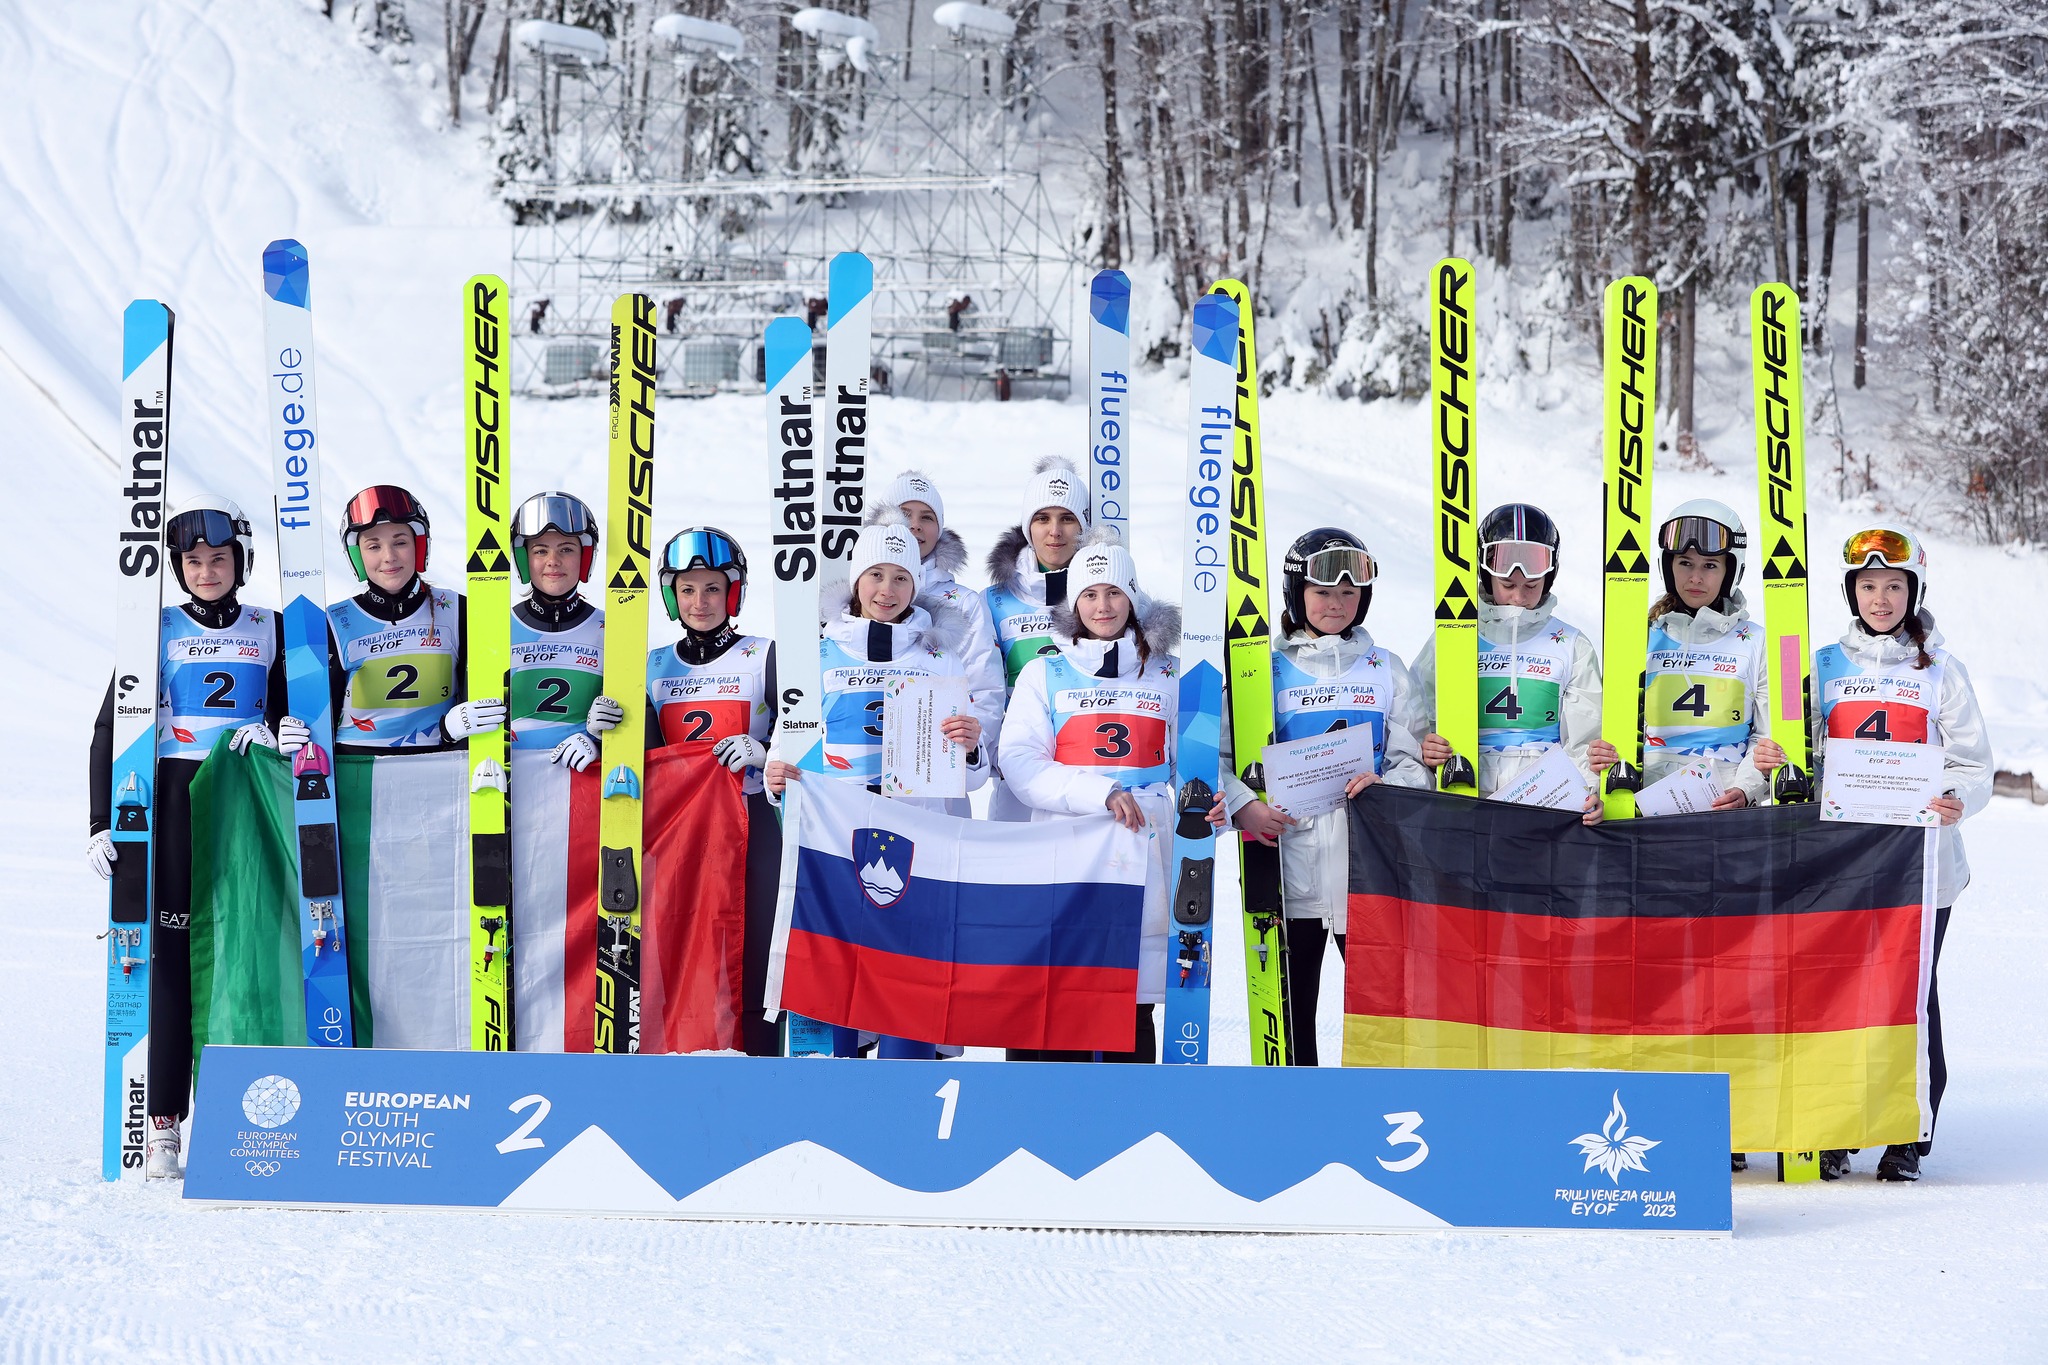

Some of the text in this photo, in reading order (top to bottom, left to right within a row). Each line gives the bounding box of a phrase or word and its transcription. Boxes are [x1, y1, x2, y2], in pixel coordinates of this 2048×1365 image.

[474, 282, 500, 522] FISCHER
[1617, 283, 1647, 524] FISCHER
[1761, 290, 1794, 529] FISCHER
[611, 405, 619, 439] EAGLE
[1439, 264, 1471, 572] FISCHER
[627, 293, 657, 560] FISCHER
[273, 347, 314, 529] fluege.de
[821, 385, 867, 561] Slatnar
[119, 398, 163, 577] Slatnar
[773, 395, 817, 581] Slatnar
[1189, 405, 1231, 592] fluege.de
[283, 567, 322, 578] fluege.de
[1284, 562, 1303, 573] uvex
[1008, 615, 1032, 627] FRIULI
[1020, 622, 1055, 633] EYOF
[178, 637, 259, 648] FRIULI VENEZIA GIULIA
[357, 629, 415, 648] FRIULI VENEZIA
[1183, 632, 1223, 642] fluege.de
[1231, 640, 1268, 648] FISCHER
[188, 646, 259, 657] EYOF 2023
[370, 637, 442, 653] EYOF 2023
[511, 644, 599, 658] FRIULI VENEZIA GIULIA
[523, 652, 599, 668] EYOF 2023
[1526, 656, 1551, 666] GIULIA
[1651, 652, 1675, 661] FRIULI
[1712, 655, 1737, 664] GIULIA
[835, 668, 901, 679] FRIULI VENEZIA
[1526, 664, 1551, 676] 2023
[1713, 663, 1737, 673] 2023
[385, 663, 419, 701] 2
[661, 676, 741, 689] FRIULI VENEZIA GIULIA
[848, 676, 884, 686] EYOF
[1834, 679, 1857, 688] FRIULI
[1895, 679, 1921, 689] GIULIA
[203, 671, 236, 709] 2
[440, 686, 449, 697] 3
[536, 676, 572, 715] 2
[670, 684, 741, 696] EYOF 2023
[1067, 689, 1161, 703] FRIULI VENEZIA GIULIA
[1289, 685, 1374, 699] FRIULI GIULIA
[1843, 685, 1920, 700] EYOF 2023
[254, 698, 264, 710] 4
[1079, 698, 1161, 712] EYOF 2023
[1301, 694, 1376, 706] EYOF 2023
[1484, 685, 1524, 720] 4
[1672, 684, 1710, 717] 4
[117, 705, 152, 714] Slatnar
[1545, 710, 1556, 722] 2
[1732, 710, 1741, 721] 3
[682, 709, 714, 742] 2
[782, 720, 819, 729] Slatnar
[1853, 709, 1893, 741] 4
[1092, 721, 1133, 759] 3
[1373, 742, 1381, 752] 4
[1154, 750, 1161, 761] 1
[160, 910, 190, 926] EA7
[108, 1001, 142, 1009] Слатнар
[344, 1091, 471, 1111] EUROPEAN
[935, 1078, 960, 1140] 1
[122, 1077, 144, 1169] Slatnar
[343, 1111, 419, 1129] YOUTH
[495, 1094, 552, 1154] 2
[237, 1132, 298, 1141] EUROPEAN
[340, 1131, 436, 1149] OLYMPIC
[1375, 1110, 1430, 1172] 3
[243, 1140, 290, 1149] OLYMPIC
[230, 1148, 300, 1159] COMMITTEES
[337, 1150, 433, 1169] FESTIVAL
[1554, 1188, 1677, 1203] FRIULI VENEZIA GIULIA
[1570, 1201, 1677, 1217] EYOF 2023
